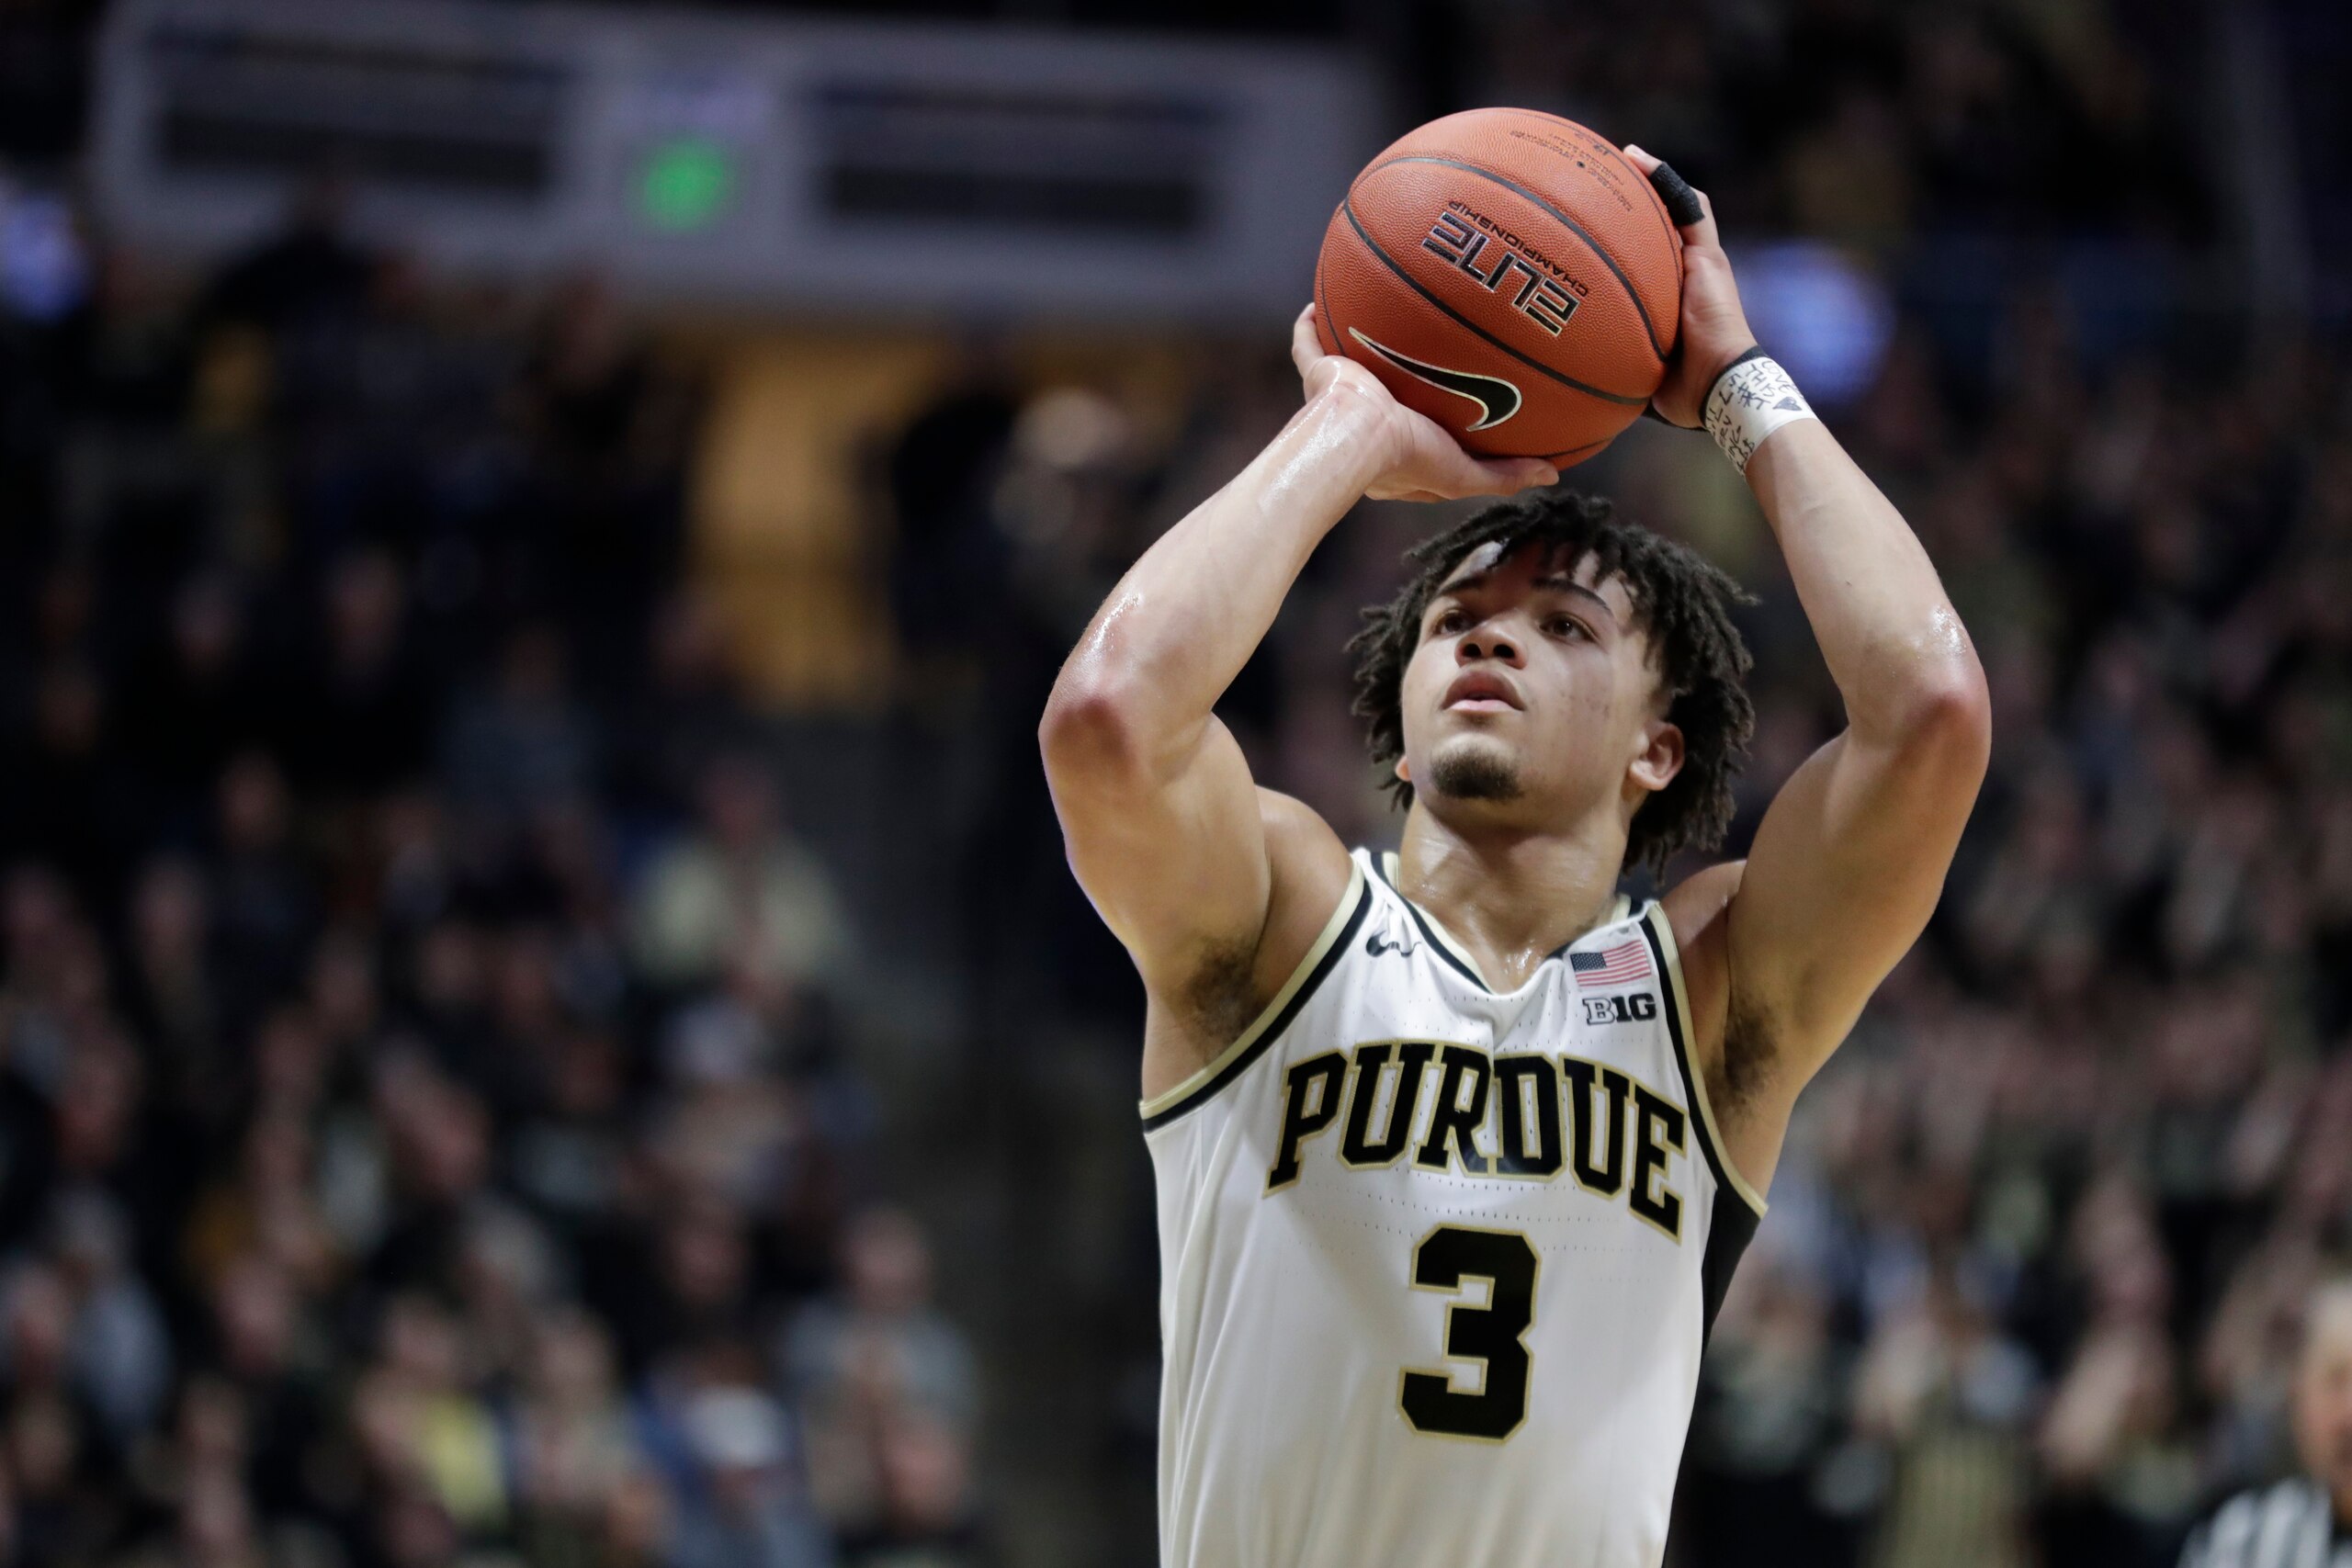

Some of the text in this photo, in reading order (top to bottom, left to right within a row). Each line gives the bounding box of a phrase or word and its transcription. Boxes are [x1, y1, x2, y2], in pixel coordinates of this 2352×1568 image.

[1422, 210, 1580, 337] ELITE
[1448, 200, 1589, 298] CHAMPIONSHIP
[1746, 364, 1776, 398] THIS
[1262, 1039, 1689, 1246] PURDUE
[1398, 1223, 1541, 1445] 3
